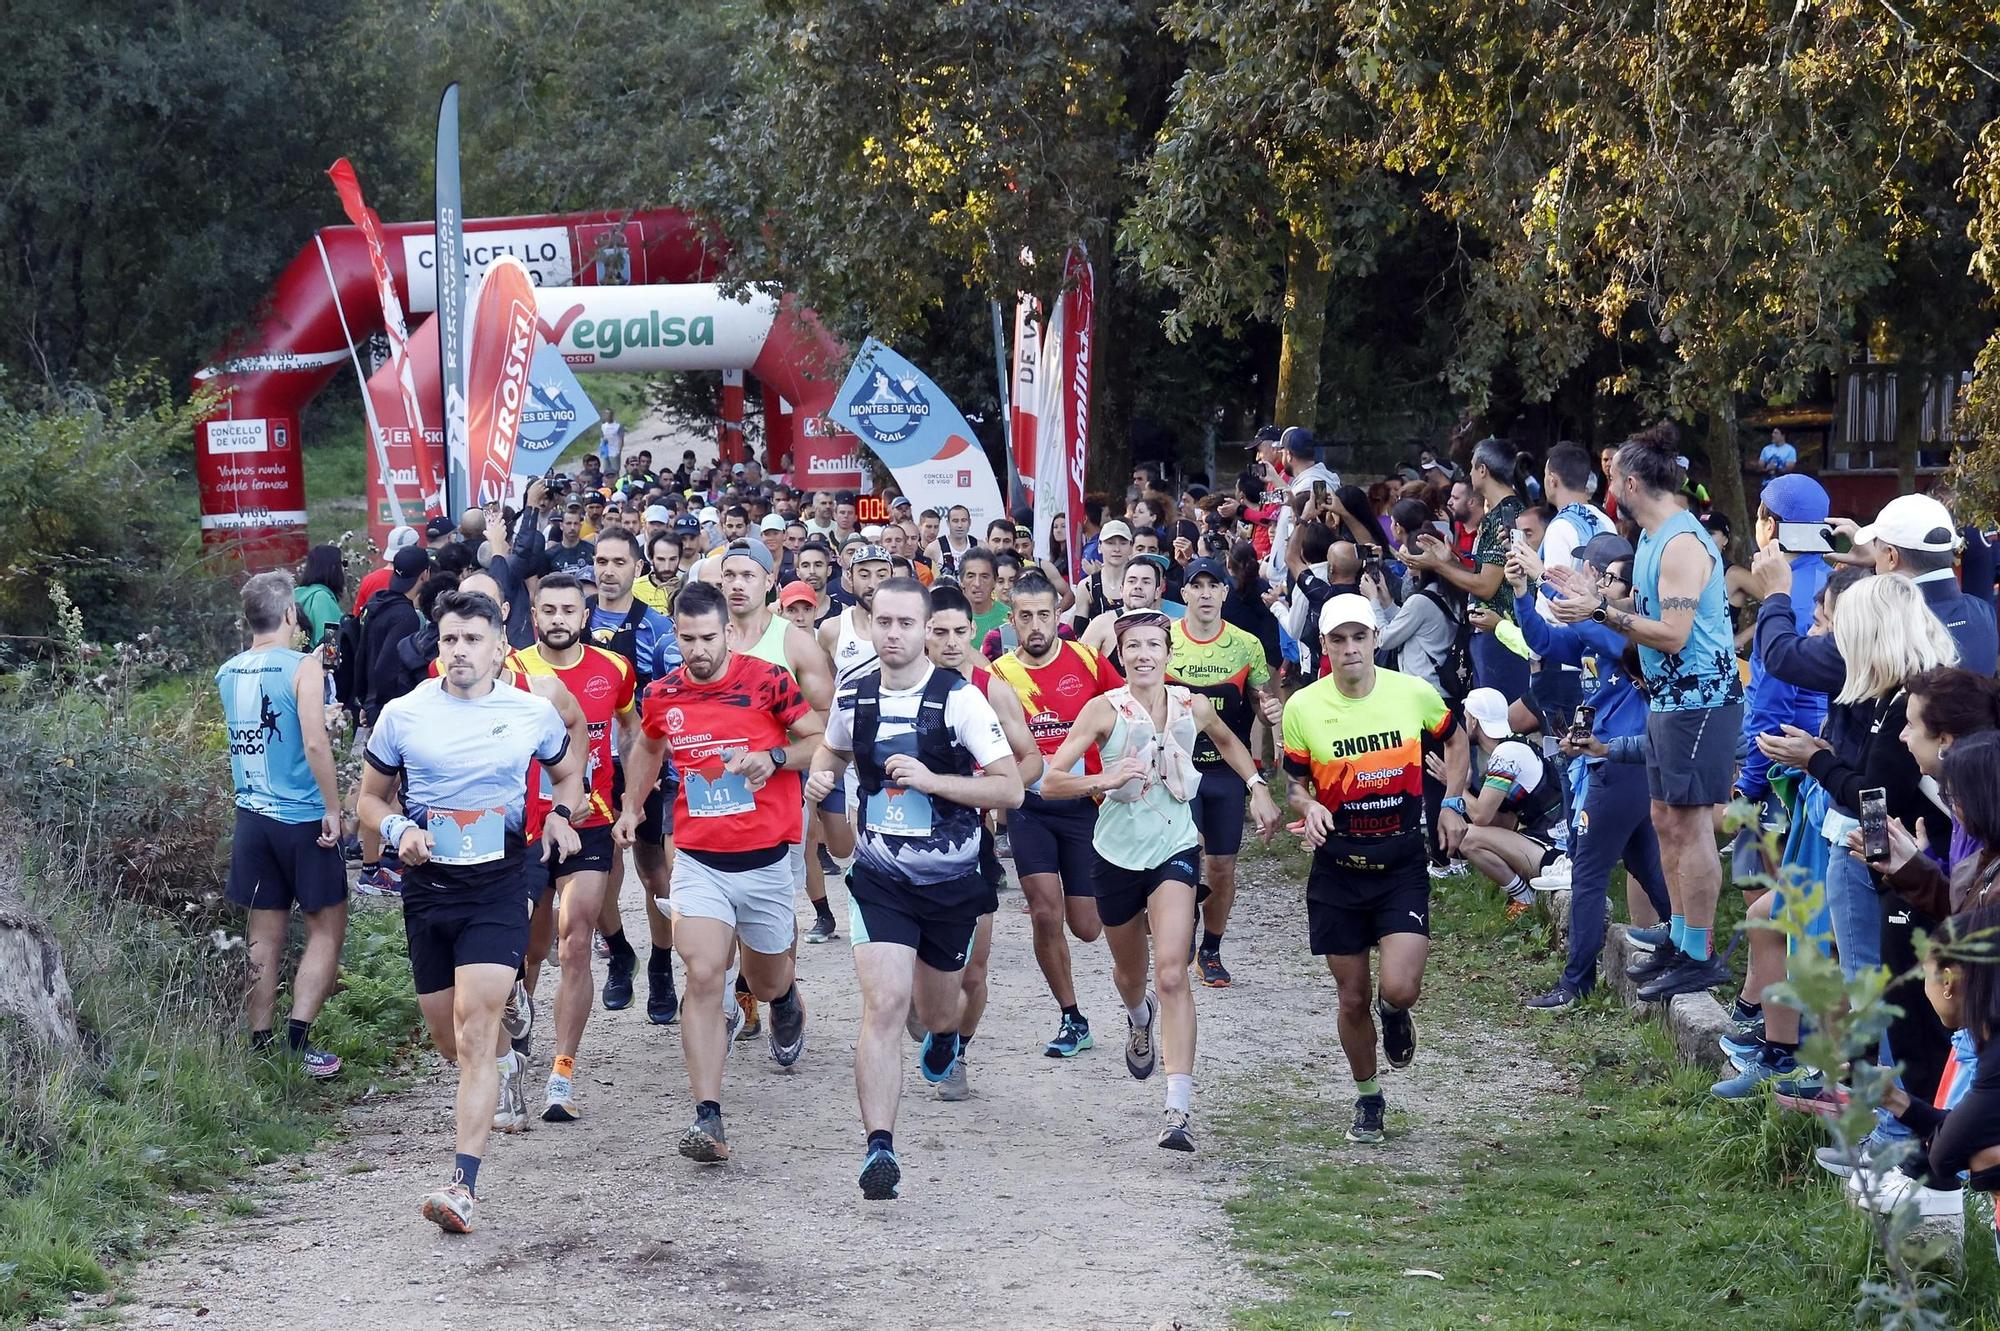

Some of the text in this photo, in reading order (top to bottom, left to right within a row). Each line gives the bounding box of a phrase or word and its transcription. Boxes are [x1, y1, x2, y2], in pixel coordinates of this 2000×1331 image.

[563, 355, 594, 363] OSKI
[493, 314, 531, 462] EROSKI
[536, 412, 551, 421] DE
[551, 411, 575, 421] VIGO
[850, 404, 929, 416] MONTES DE VIGO
[210, 426, 262, 437] CONCELLO
[393, 430, 444, 443] ERSKI
[874, 430, 906, 443] TRAIL
[216, 437, 256, 447] DE VIGO
[522, 438, 554, 450] TRAIL
[672, 733, 712, 746] Atletismo
[1034, 729, 1045, 738] de
[1332, 730, 1403, 758] 3NORTH
[1356, 767, 1404, 781] Gasóleos
[1356, 776, 1390, 789] Amigo
[704, 788, 731, 804] 141
[885, 805, 905, 822] 56
[462, 835, 473, 850] 3
